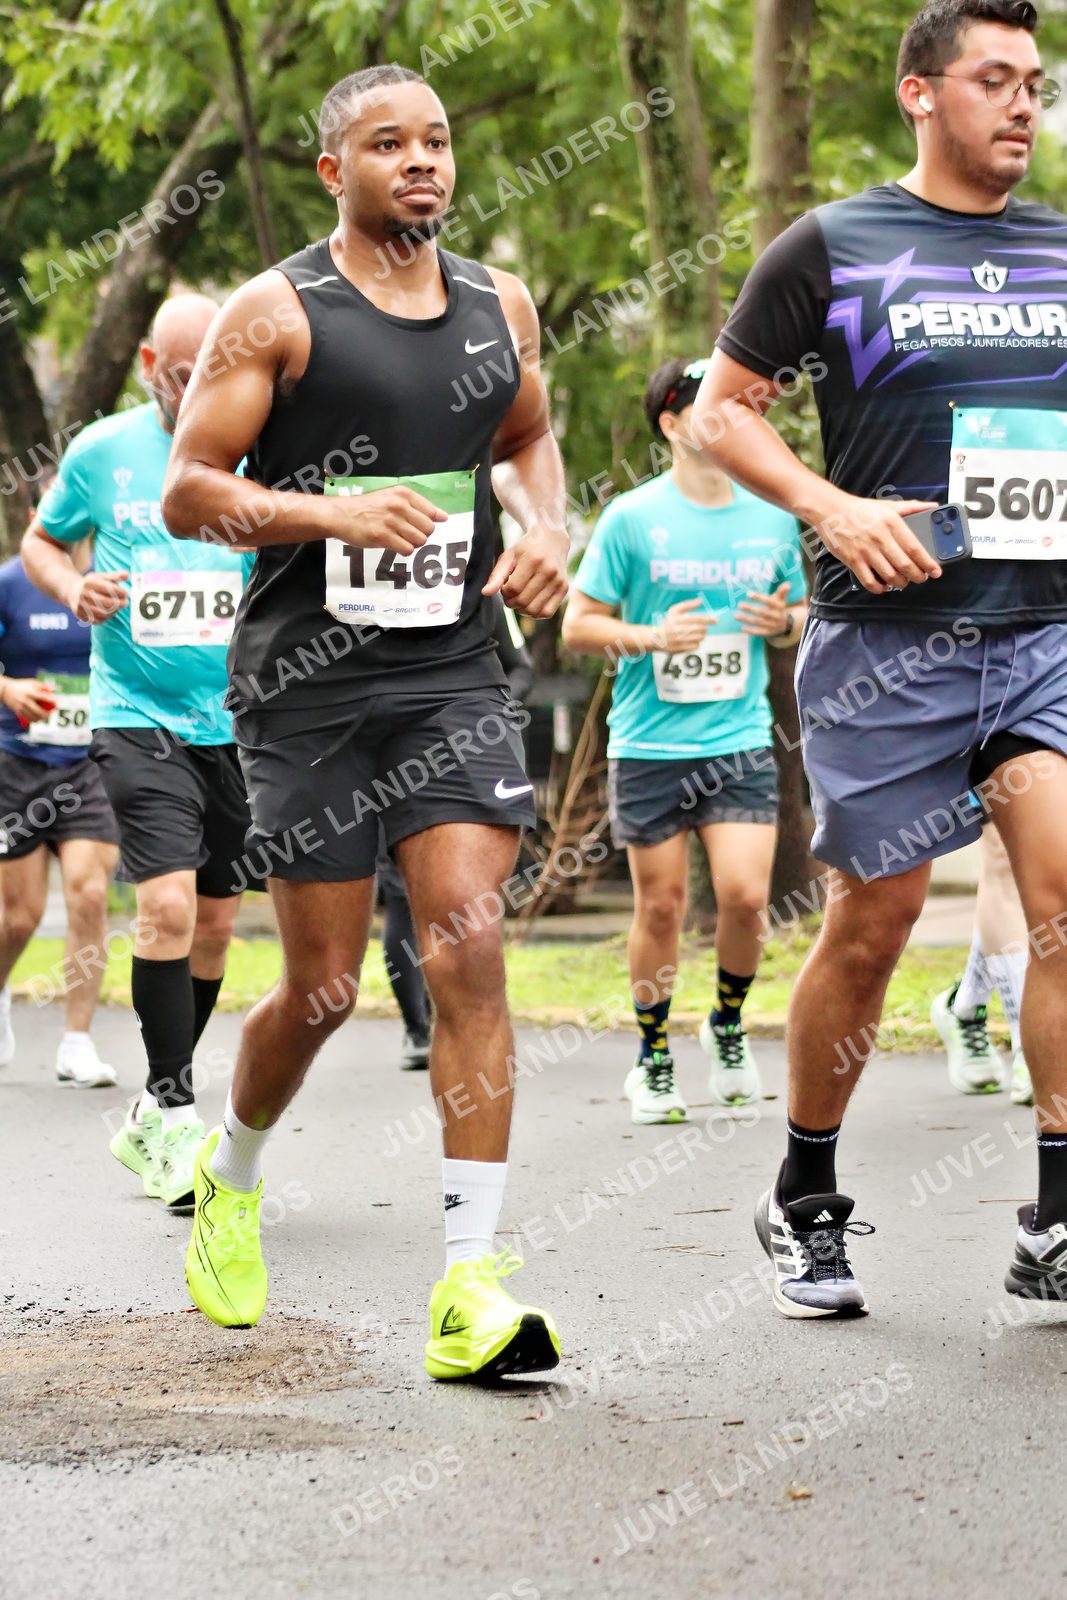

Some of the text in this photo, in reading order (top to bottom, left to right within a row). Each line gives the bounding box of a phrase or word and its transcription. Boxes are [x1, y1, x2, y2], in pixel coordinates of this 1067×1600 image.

[894, 342, 928, 352] PEGA
[930, 337, 964, 347] PISOS
[964, 476, 1067, 521] 5607
[342, 541, 468, 589] 1465
[139, 591, 235, 620] 6718
[339, 603, 375, 612] PERDURA
[662, 651, 742, 679] 4958
